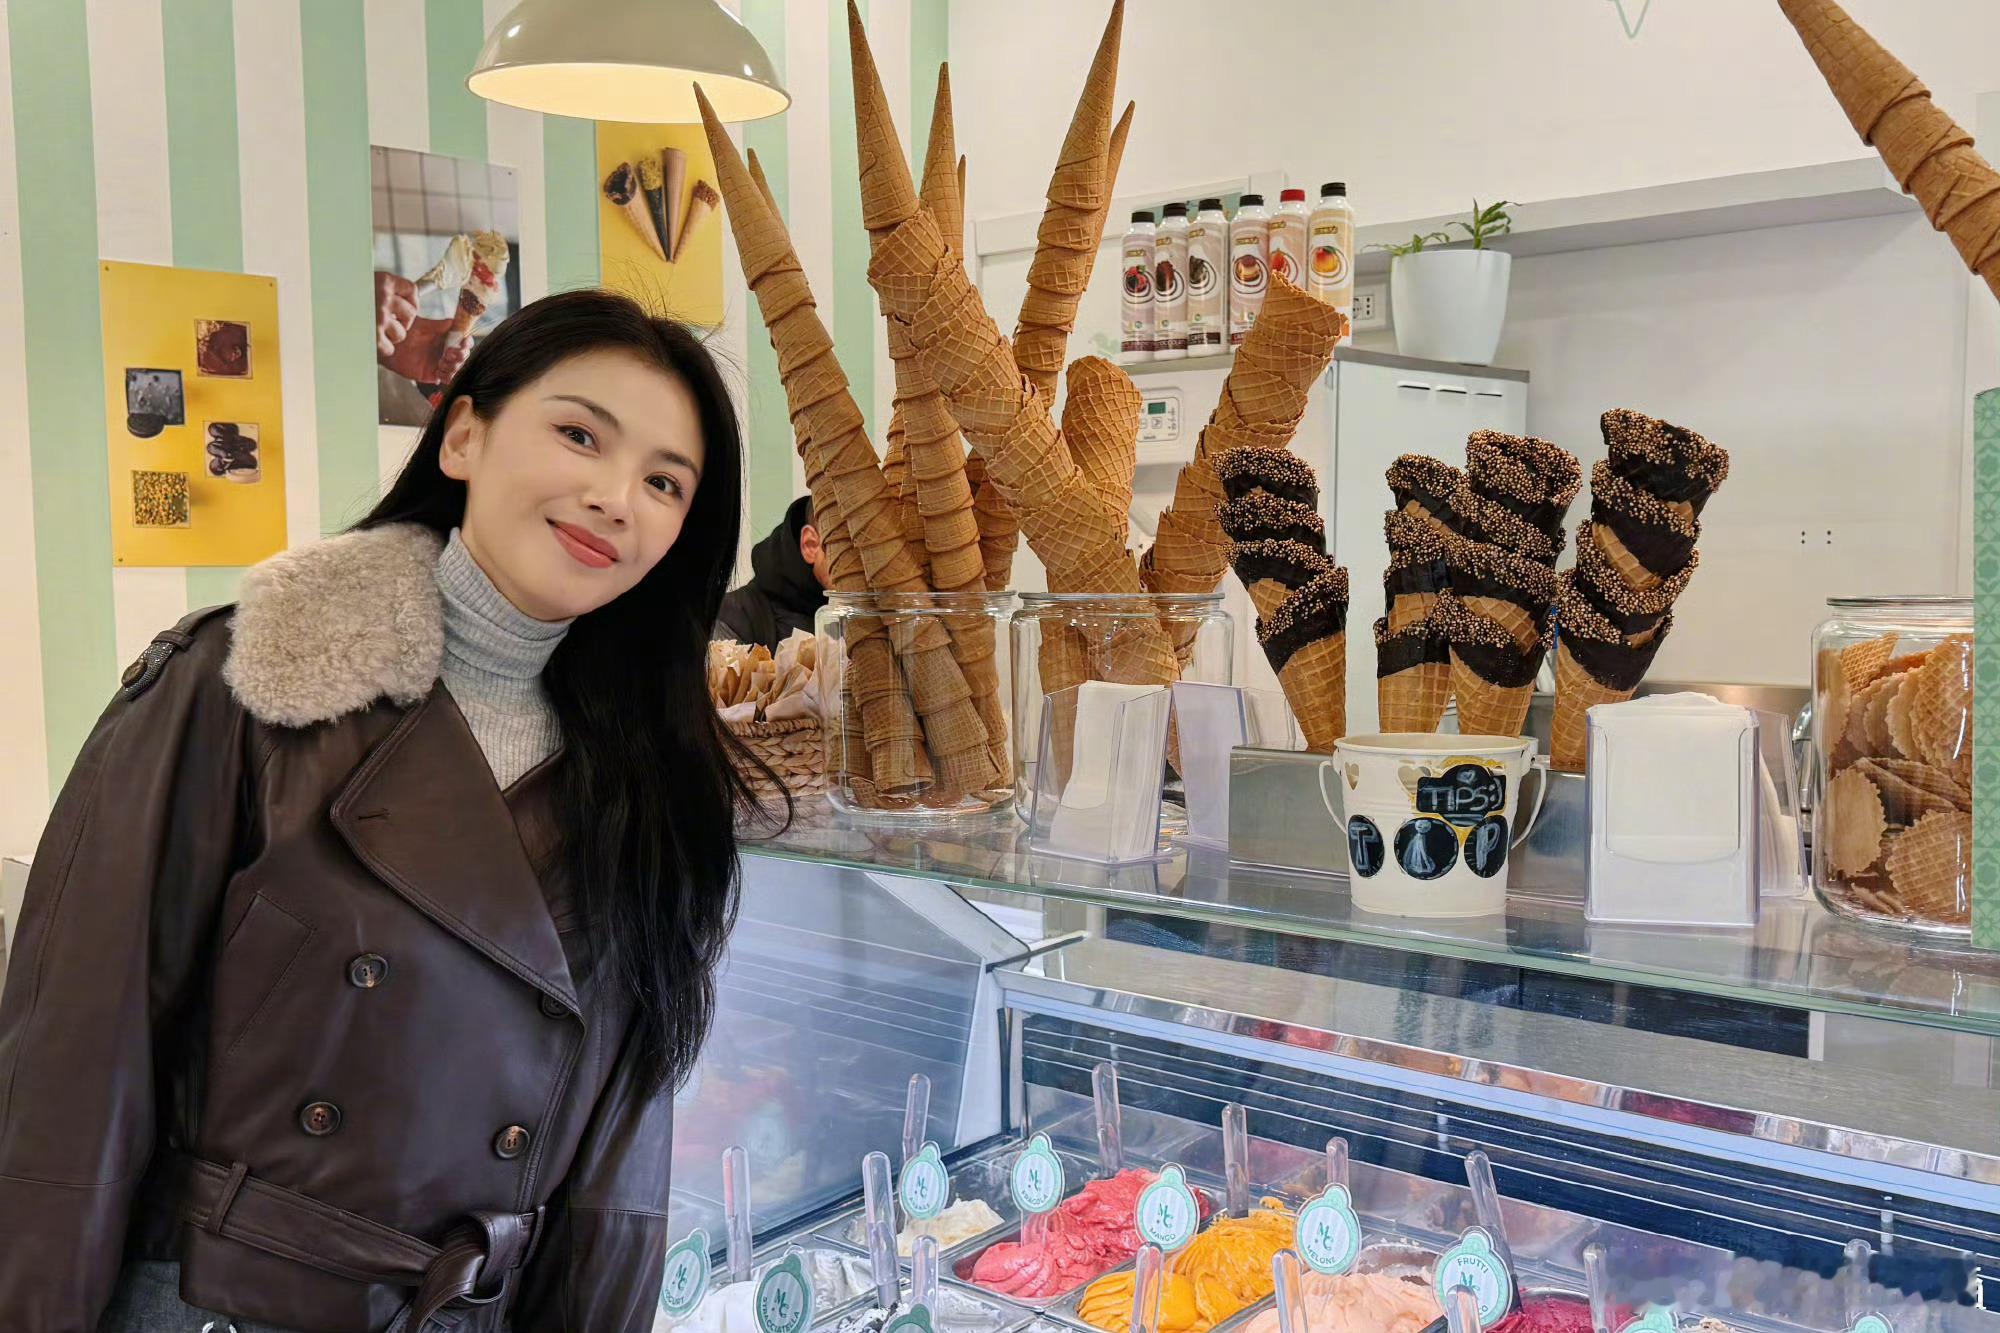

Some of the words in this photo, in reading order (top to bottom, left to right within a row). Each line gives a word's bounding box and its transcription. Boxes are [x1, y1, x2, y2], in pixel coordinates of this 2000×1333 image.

[1021, 1190, 1049, 1205] FRAGOLA
[1149, 1227, 1176, 1241] MANGO
[1307, 1245, 1336, 1264] MELONE
[1457, 1257, 1489, 1274] FRUTTI
